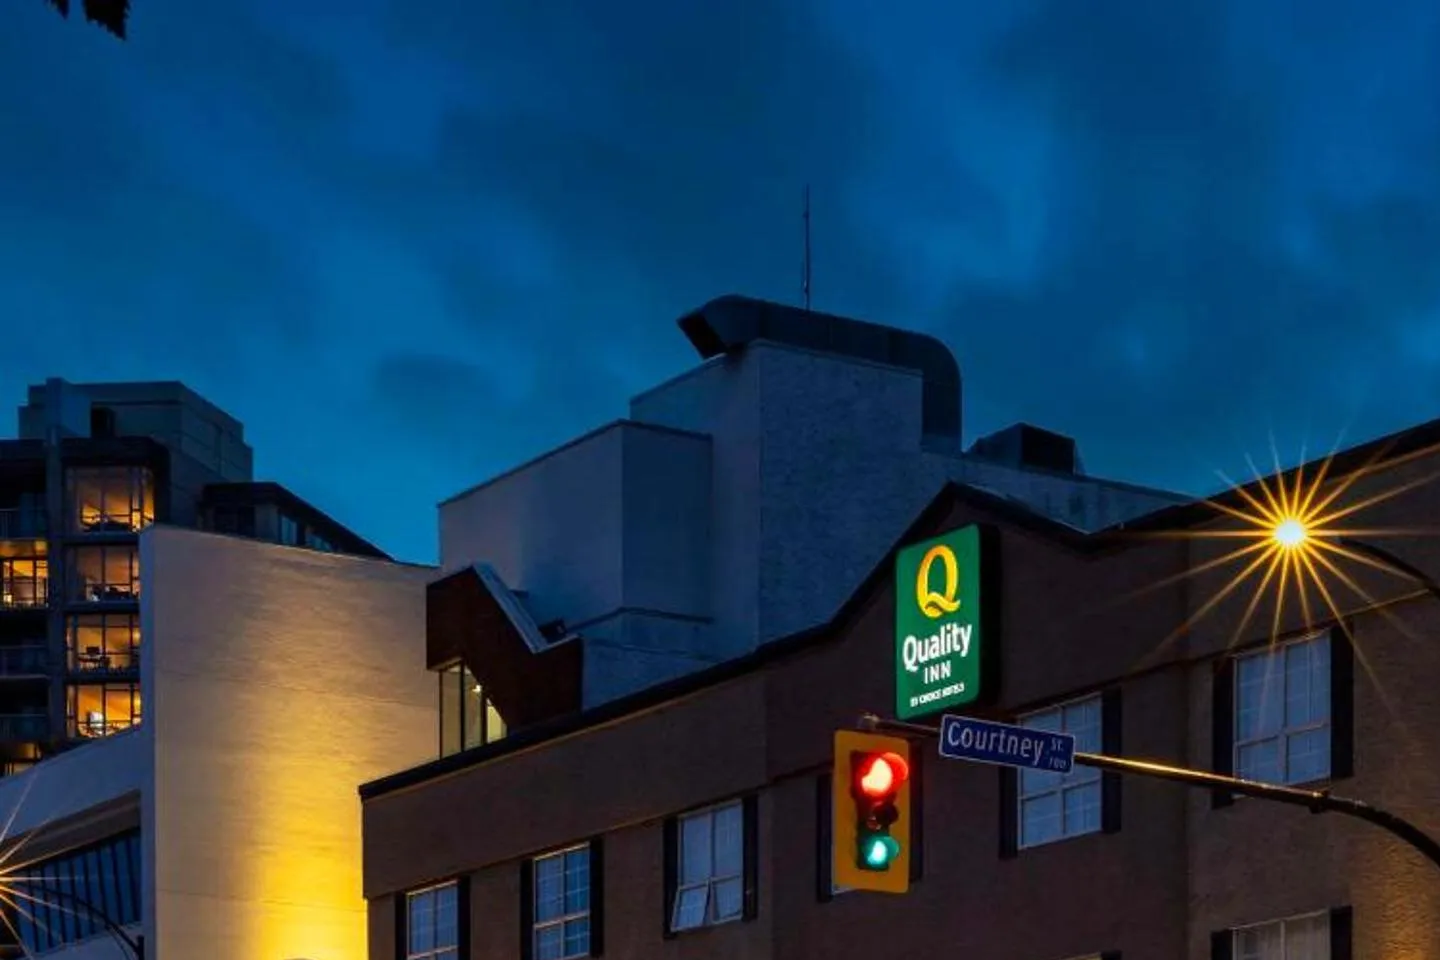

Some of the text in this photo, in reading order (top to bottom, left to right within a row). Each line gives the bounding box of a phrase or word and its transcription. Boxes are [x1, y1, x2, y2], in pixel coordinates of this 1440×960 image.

[916, 544, 961, 618] Q
[902, 622, 973, 672] Quality
[924, 660, 952, 684] INN
[947, 721, 1044, 766] Courtney
